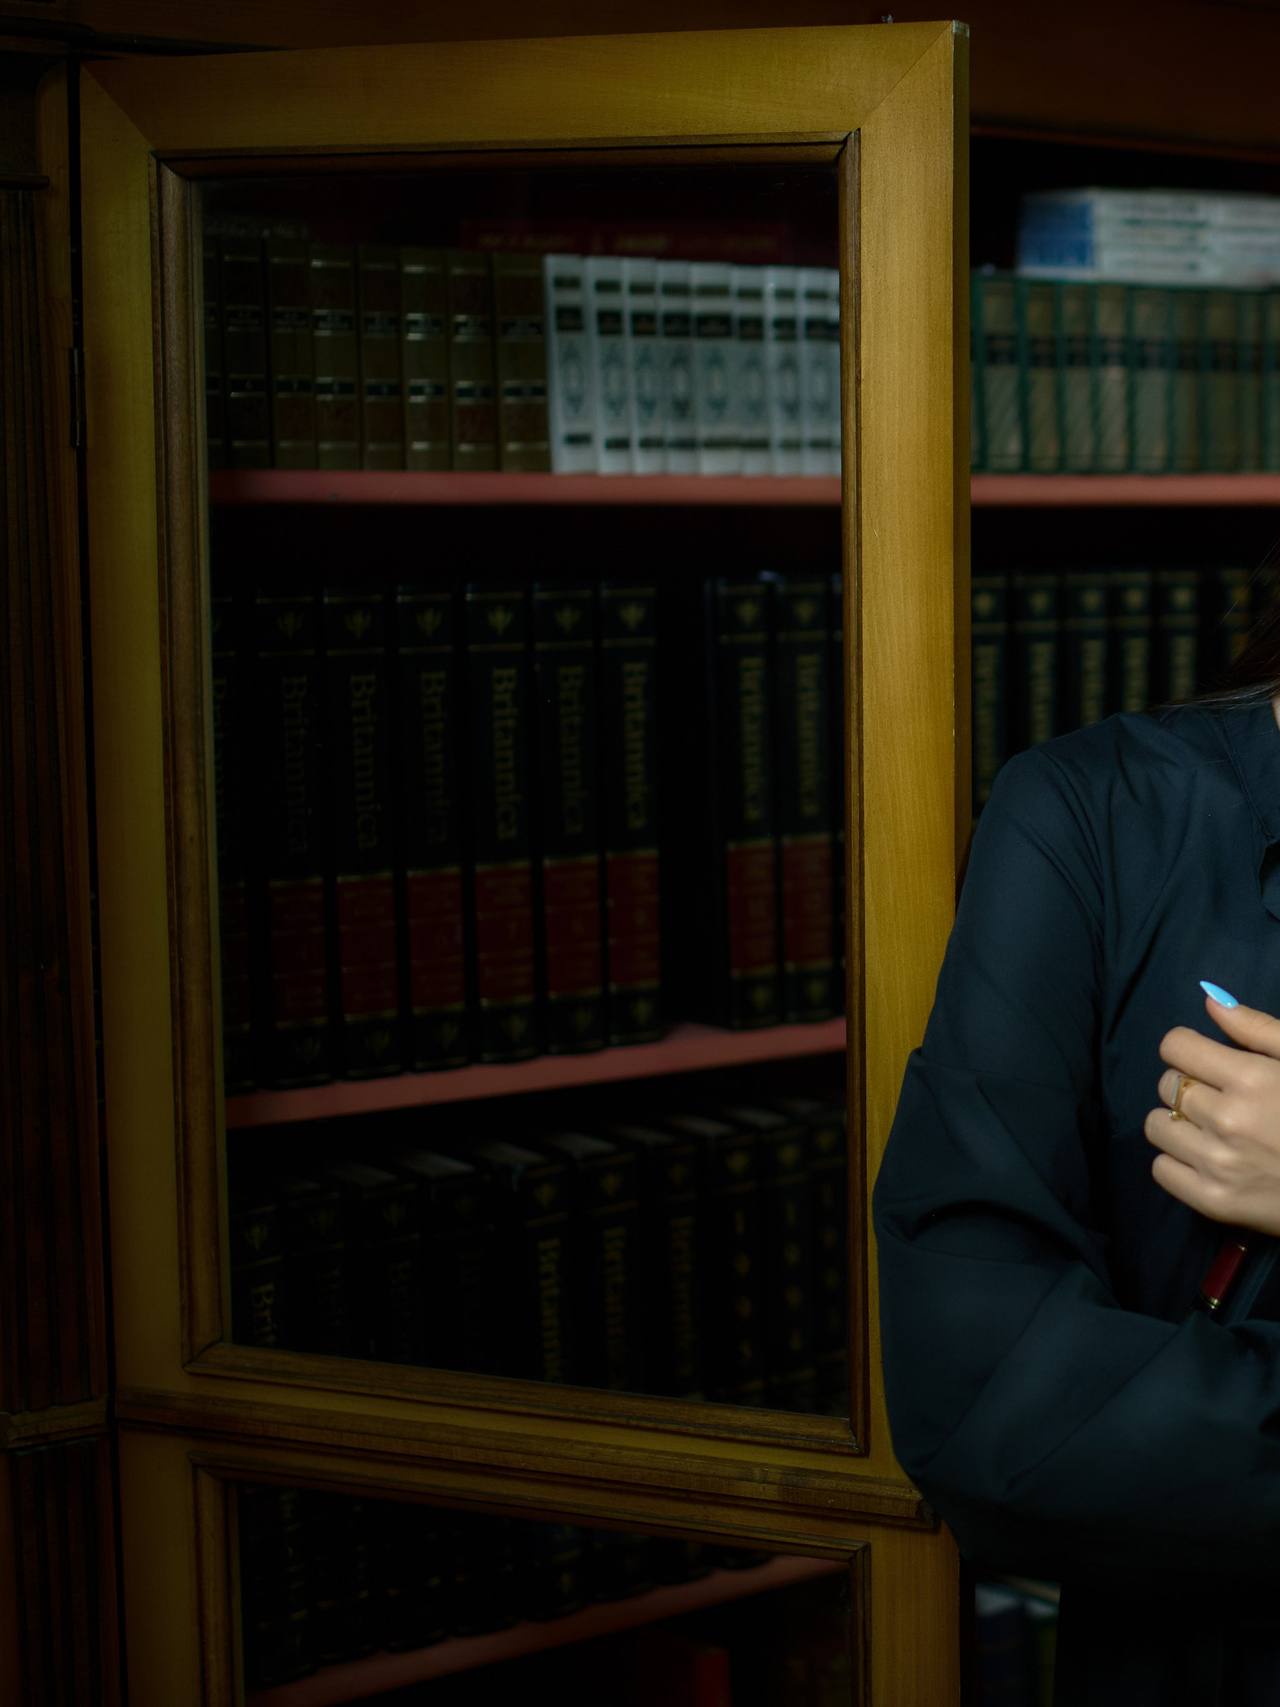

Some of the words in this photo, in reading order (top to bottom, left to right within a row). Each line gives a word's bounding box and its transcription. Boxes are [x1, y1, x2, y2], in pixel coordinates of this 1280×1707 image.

[350, 672, 382, 851] Britannica
[420, 670, 450, 847] Britannica
[491, 667, 522, 841] Britannica
[558, 664, 589, 836] Britannica
[621, 661, 650, 830] Britannica
